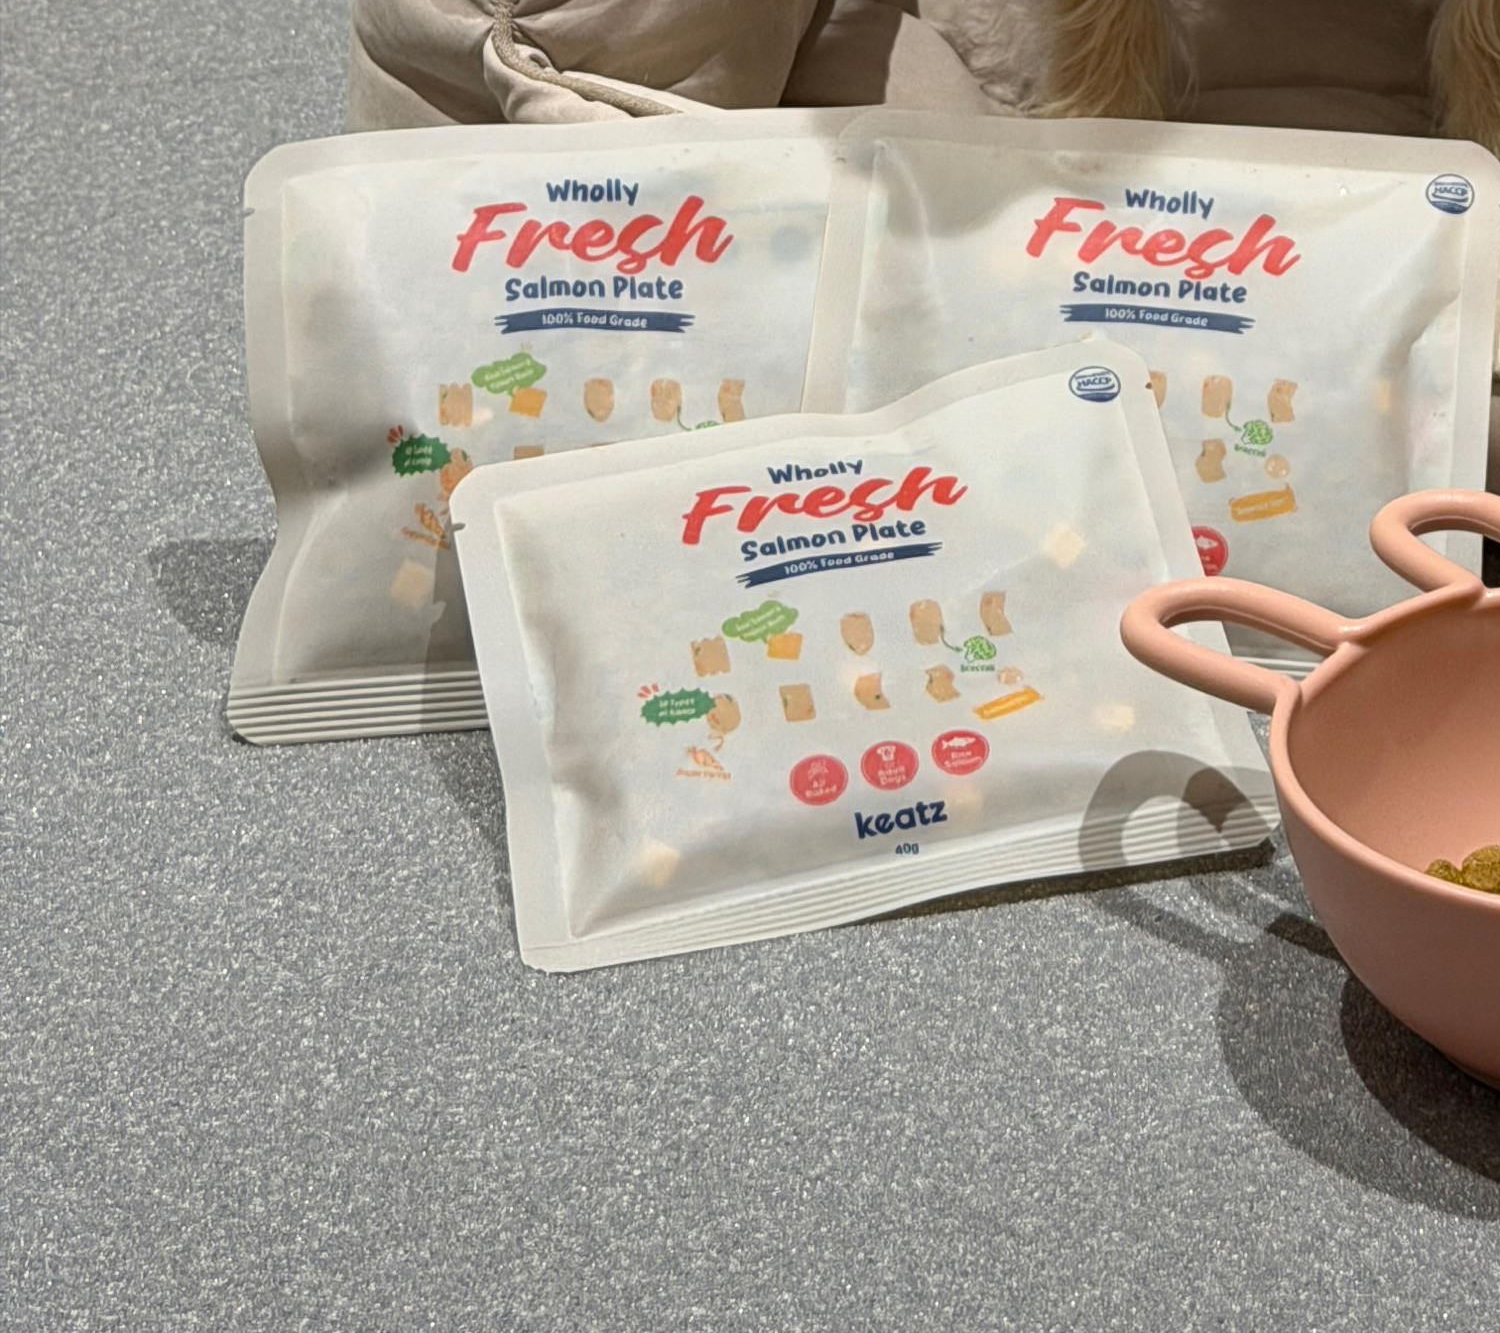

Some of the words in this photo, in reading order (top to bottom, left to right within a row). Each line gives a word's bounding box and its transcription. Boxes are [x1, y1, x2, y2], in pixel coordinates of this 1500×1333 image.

[546, 179, 639, 206] Wholly
[1125, 189, 1215, 220] Wholly
[452, 195, 734, 275] Fresh
[1026, 197, 1301, 280] Fresh
[505, 276, 606, 301] Salmon
[613, 276, 684, 300] Plate
[1073, 271, 1171, 299] Salmon
[1178, 280, 1248, 303] Plate
[542, 313, 574, 326] 100%
[576, 313, 607, 325] Food
[609, 315, 648, 328] Grade
[1105, 308, 1136, 320] 100%
[1139, 309, 1168, 323] Food
[1171, 313, 1209, 327] Grade
[767, 459, 863, 484] Wholly
[682, 466, 968, 545] Fresh
[740, 529, 846, 562] Salmon
[851, 520, 927, 542] Plate
[784, 560, 818, 575] 100%
[820, 555, 852, 567] Food
[855, 551, 895, 563] Grade
[854, 800, 948, 839] keatz
[895, 843, 919, 854] 40g
